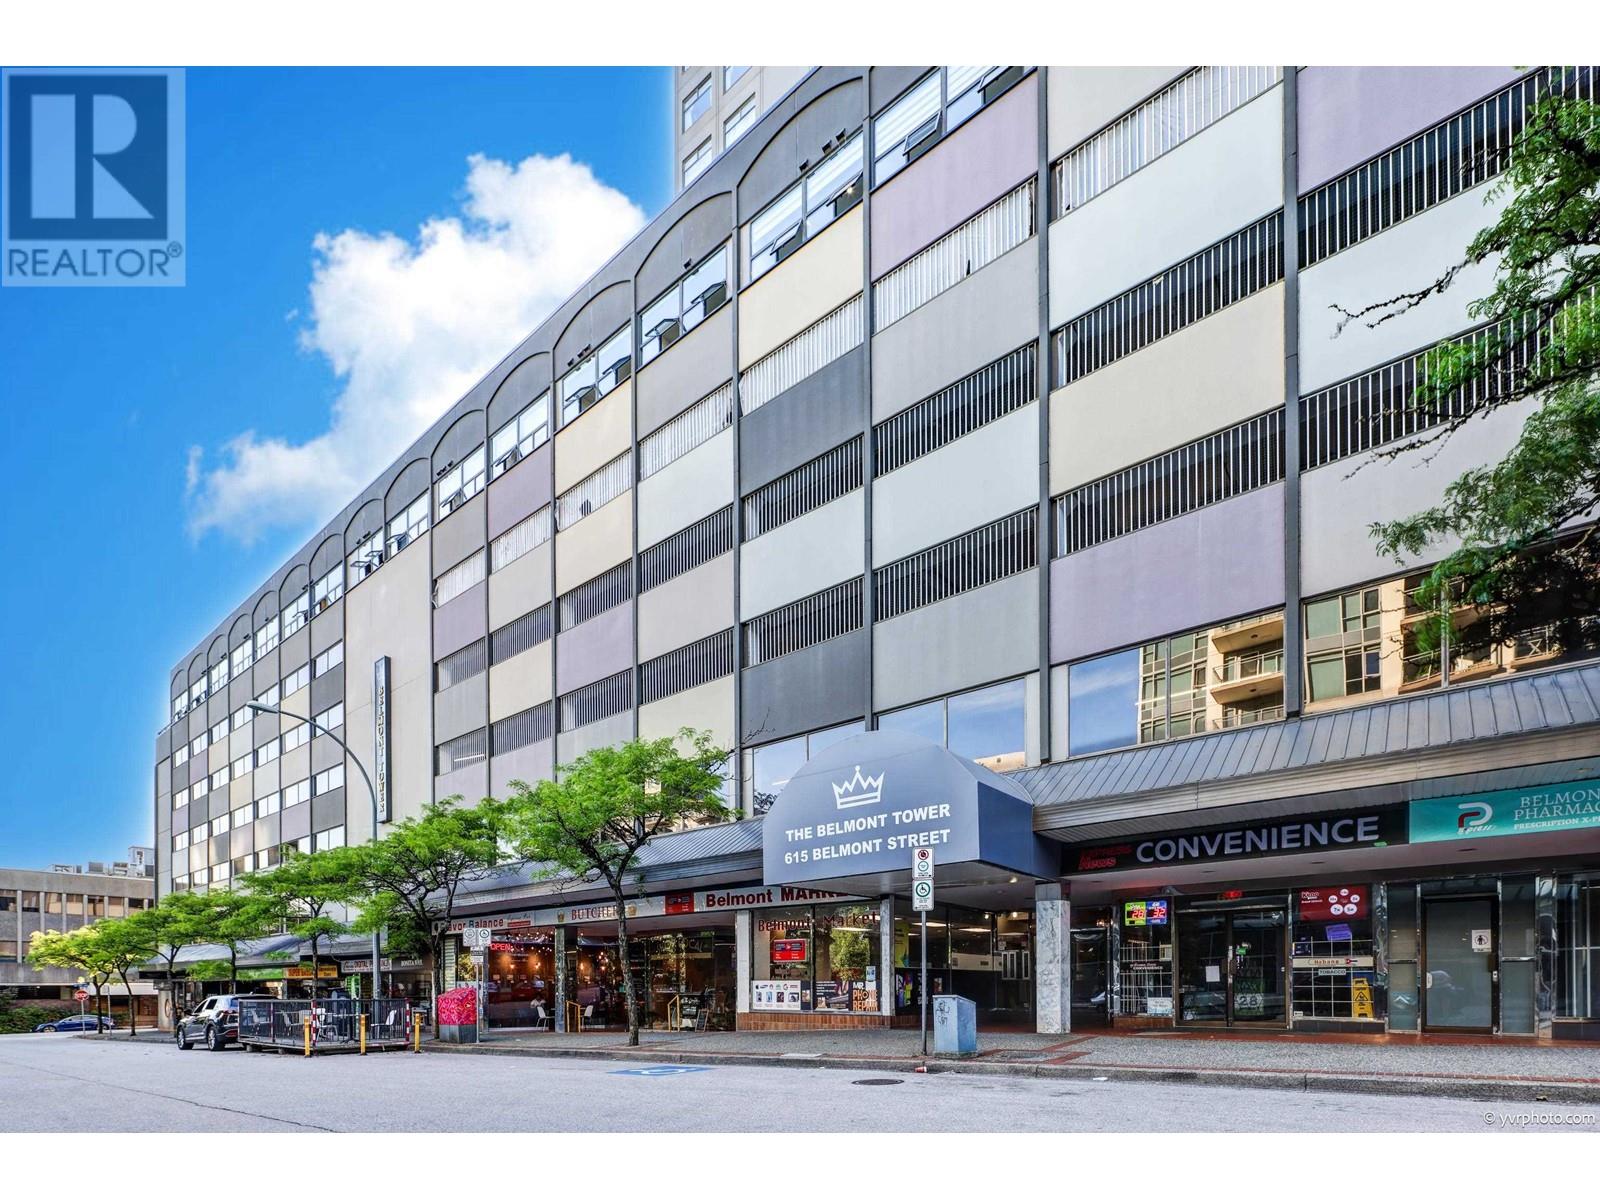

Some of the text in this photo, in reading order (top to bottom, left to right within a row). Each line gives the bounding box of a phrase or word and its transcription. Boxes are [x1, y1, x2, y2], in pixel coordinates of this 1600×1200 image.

[786, 803, 951, 842] THE BELMONT TOWER
[1513, 818, 1578, 830] PRESCRIPTION
[784, 829, 951, 865] 615 BELMONT STREET
[1136, 816, 1380, 863] CONVENIENCE
[706, 889, 773, 907] Belmont
[758, 911, 878, 932] Belmont Market
[1153, 908, 1166, 917] 32
[490, 943, 511, 951] OPEN
[852, 1001, 878, 1012] REPAIR
